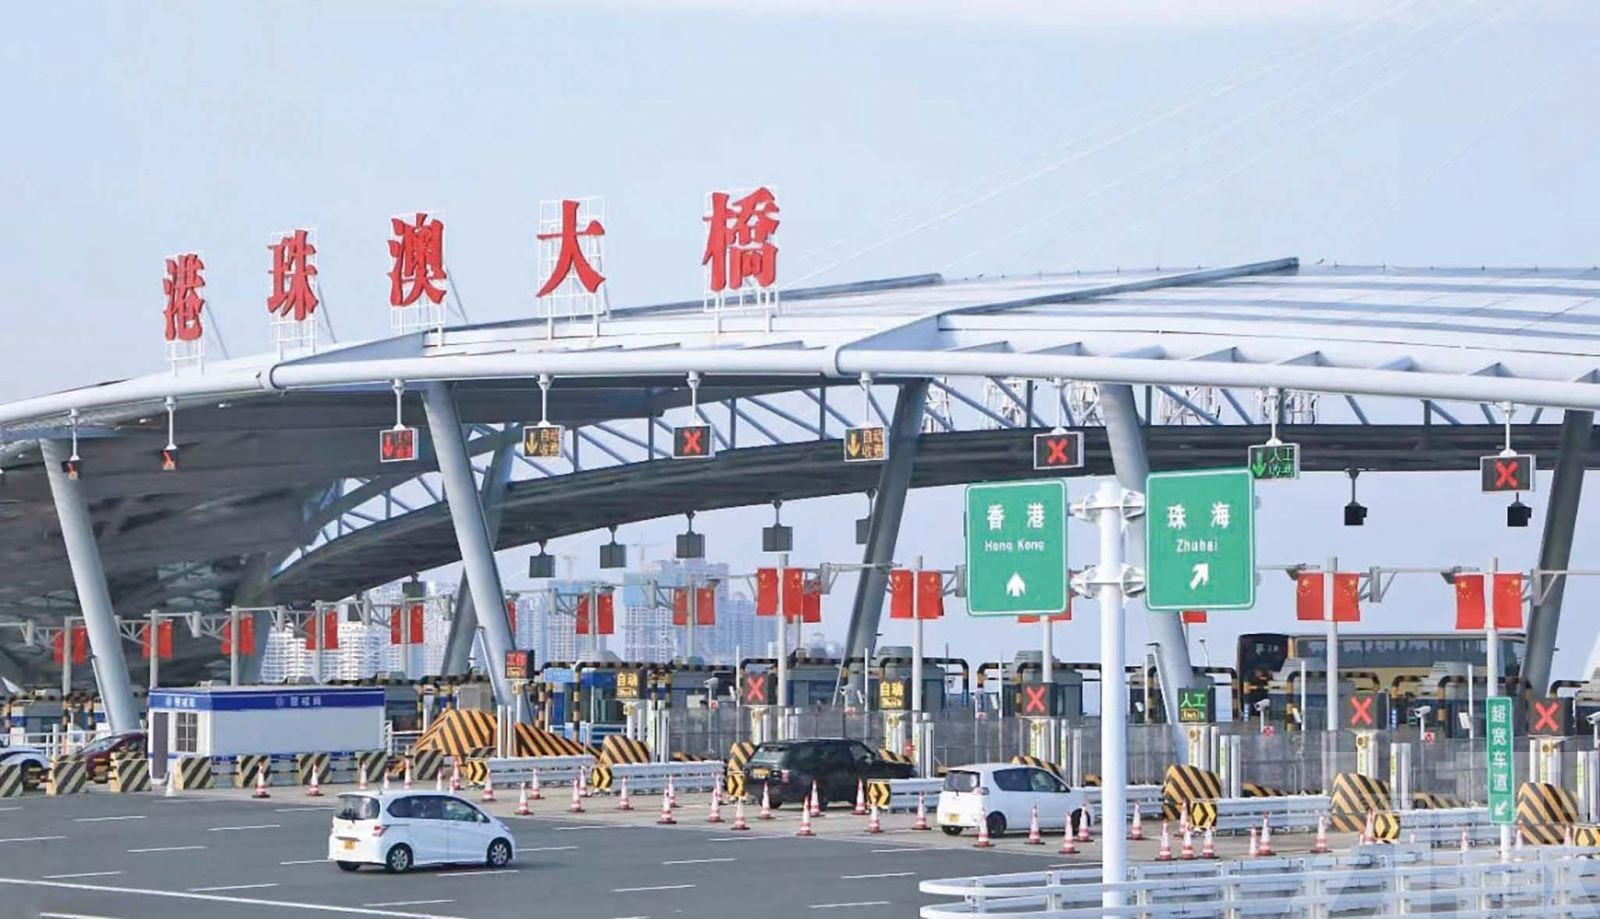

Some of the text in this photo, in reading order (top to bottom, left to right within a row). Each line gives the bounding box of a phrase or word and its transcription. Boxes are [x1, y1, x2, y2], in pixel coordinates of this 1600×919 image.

[162, 186, 780, 341] 港珠澳大橋
[1269, 447, 1293, 462] 人工
[987, 502, 1045, 531] 香港
[1167, 502, 1230, 530] 珠海
[985, 540, 1044, 552] Hong Kong
[1177, 539, 1218, 552] Zhuhai
[1180, 692, 1206, 708] 人工
[1491, 704, 1508, 791] 超宽车道
